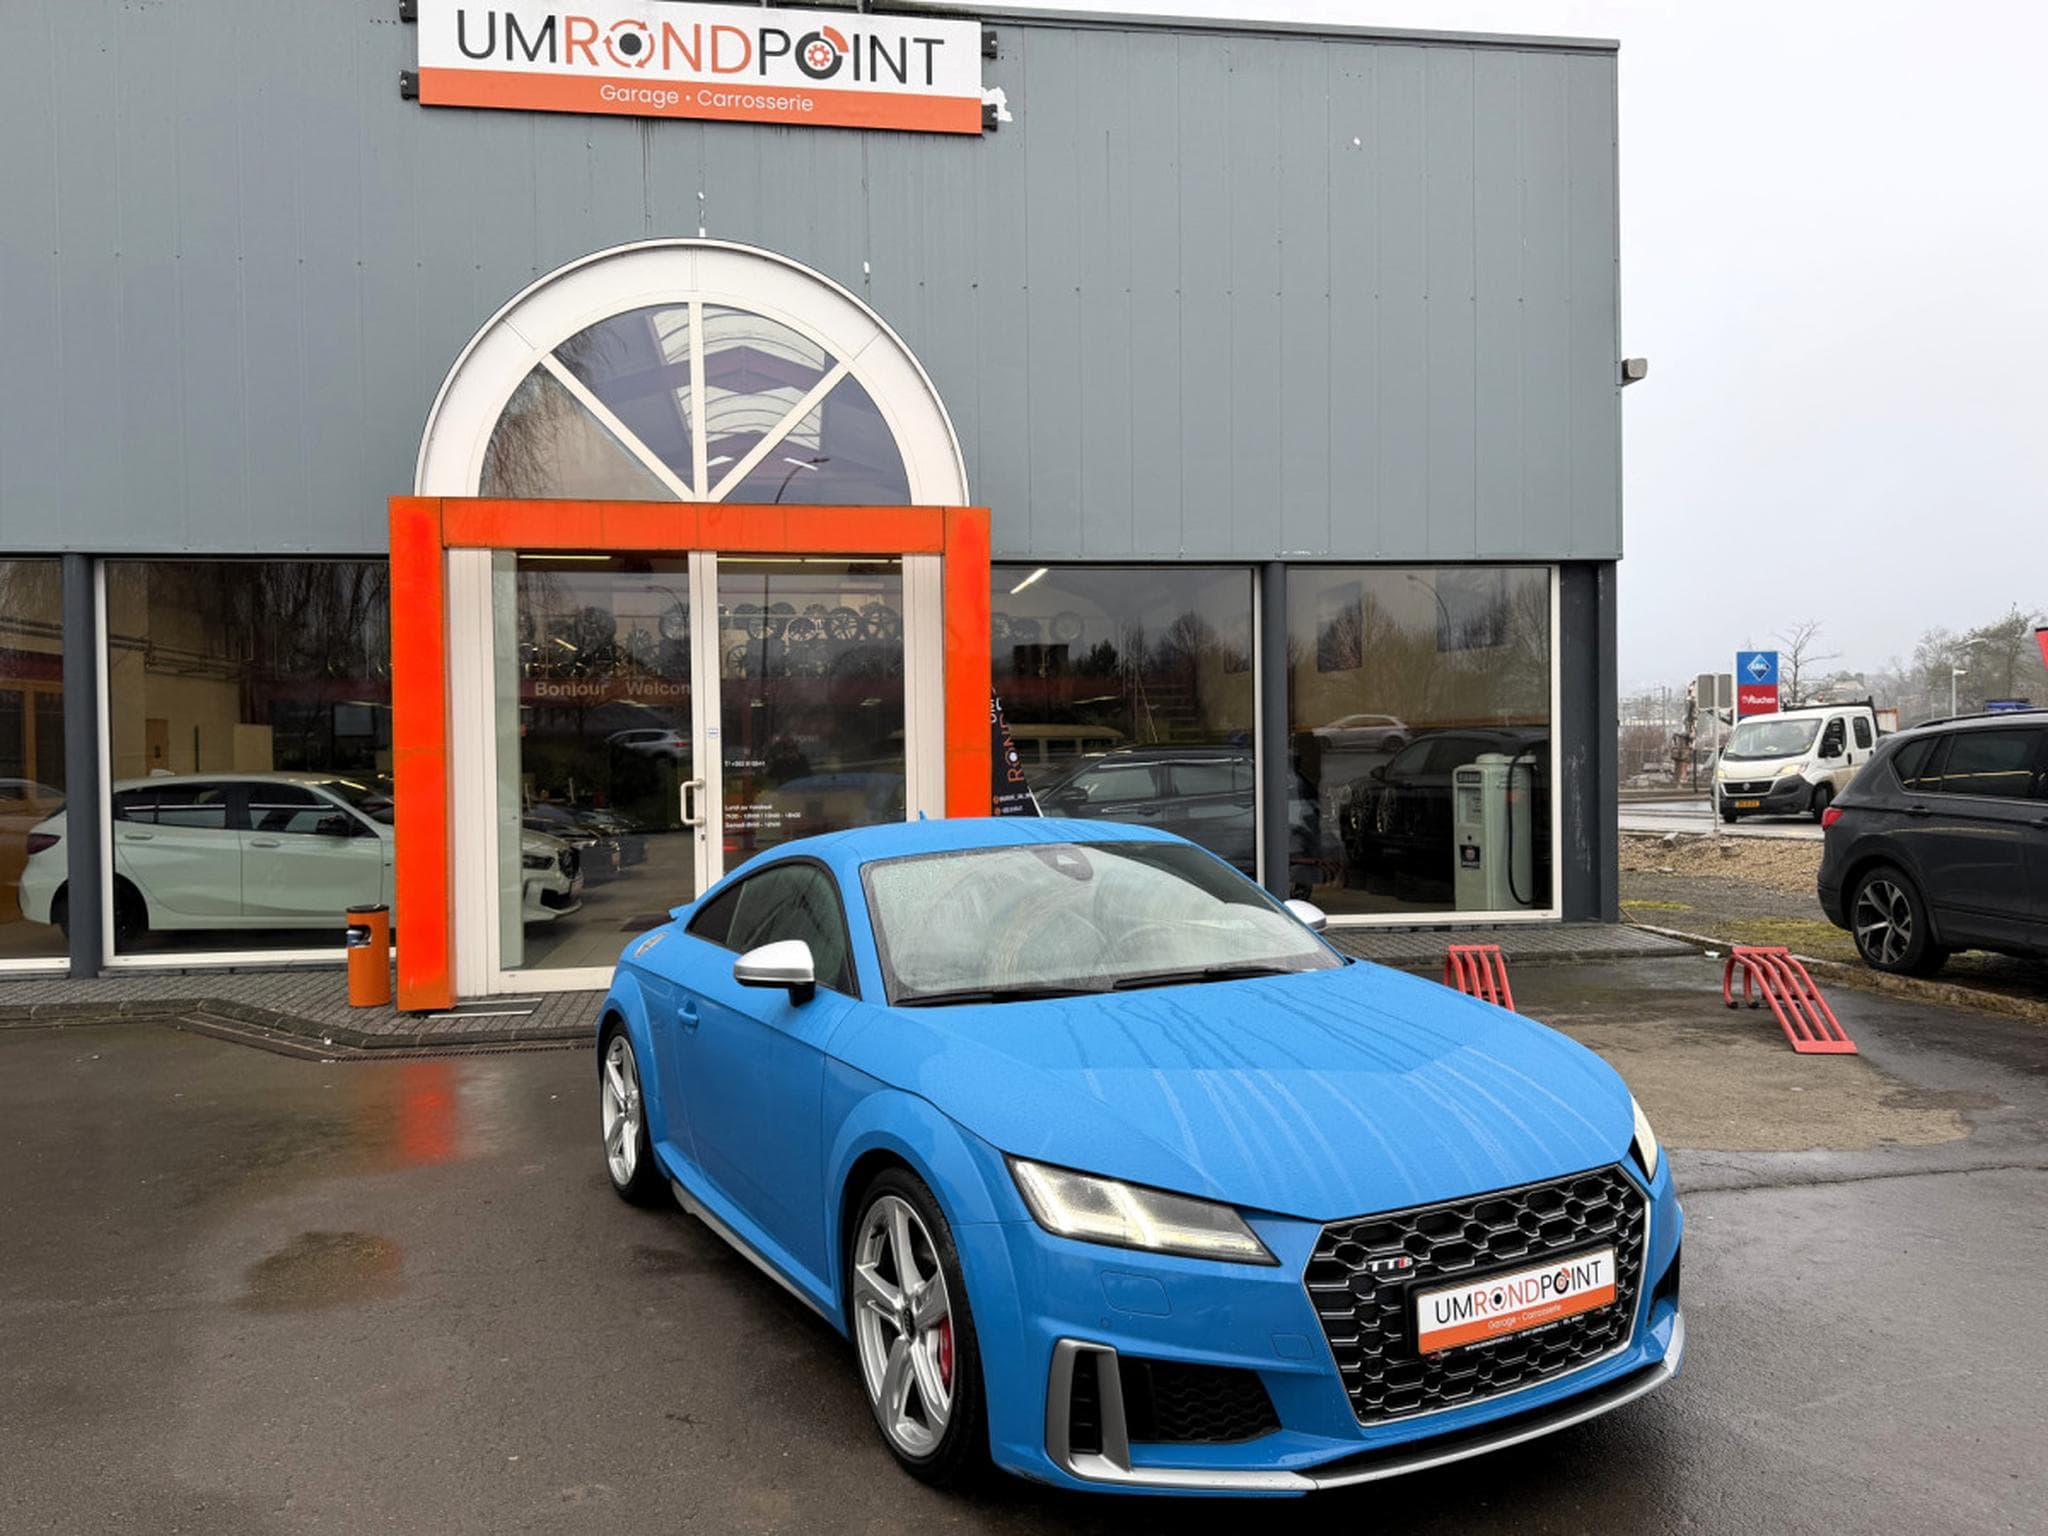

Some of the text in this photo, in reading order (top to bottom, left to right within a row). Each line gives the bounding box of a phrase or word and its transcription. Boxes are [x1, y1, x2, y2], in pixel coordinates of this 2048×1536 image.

[600, 84, 814, 112] Garage Carrosserie
[535, 681, 607, 698] Bonjour
